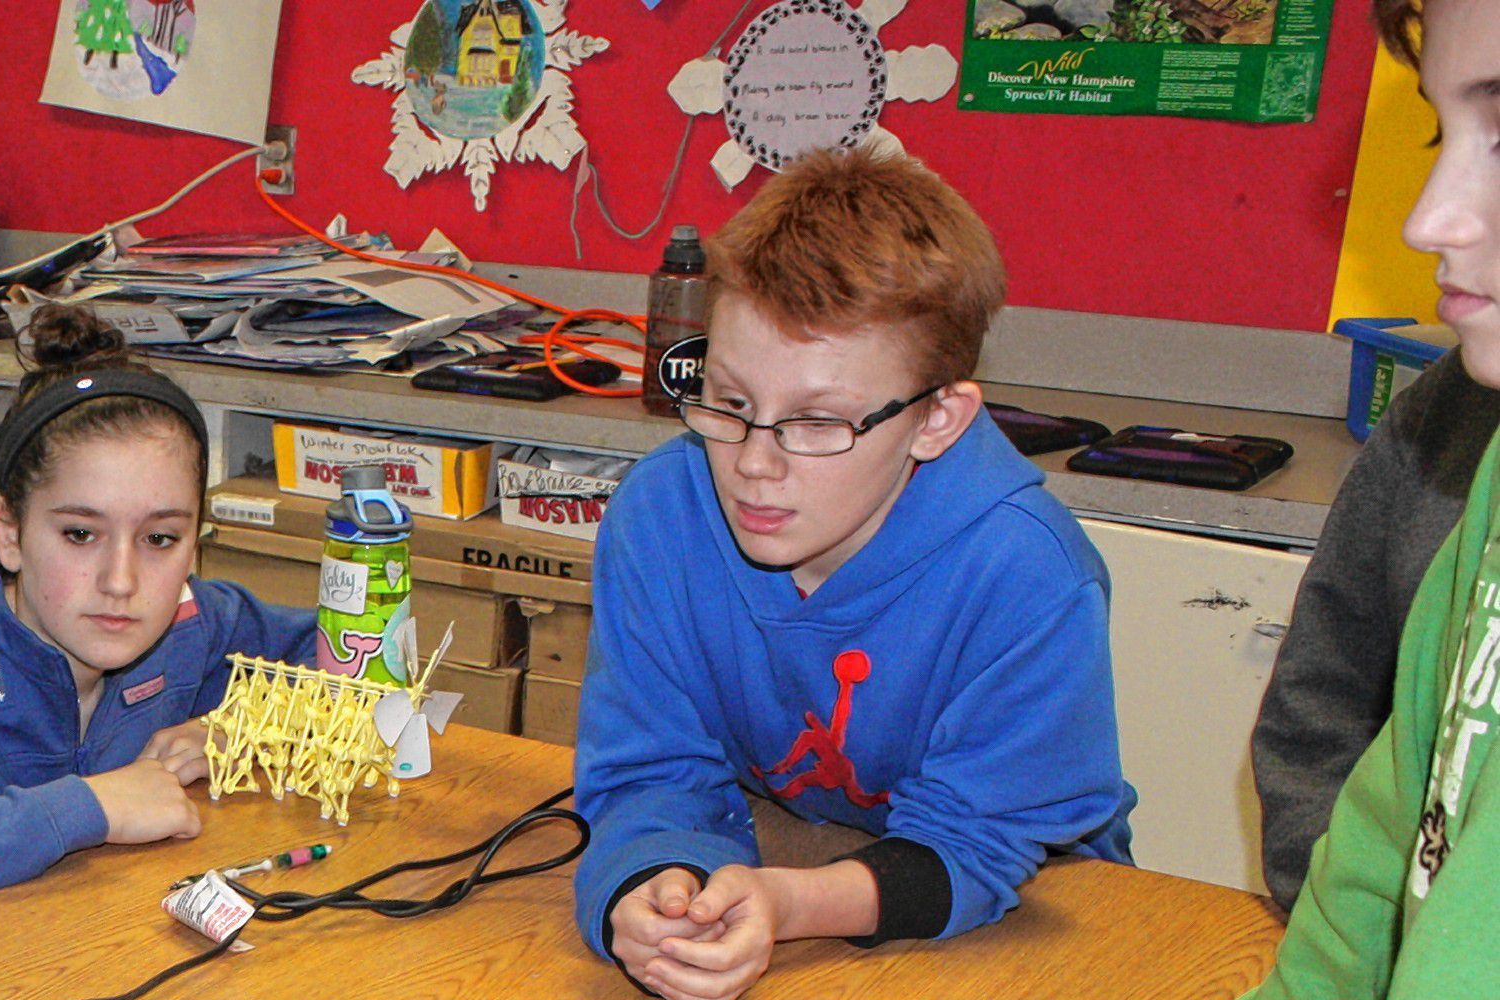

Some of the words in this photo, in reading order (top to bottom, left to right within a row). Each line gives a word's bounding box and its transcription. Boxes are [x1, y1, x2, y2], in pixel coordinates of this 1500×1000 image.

[1017, 47, 1095, 80] Wild
[987, 71, 1033, 84] Discover
[1043, 73, 1069, 85] New
[1072, 74, 1136, 89] Hampshire
[1004, 87, 1067, 102] Spruce/Fir
[1069, 90, 1112, 103] Habitat
[300, 434, 344, 450] Winter
[462, 547, 574, 578] FRAGILE
